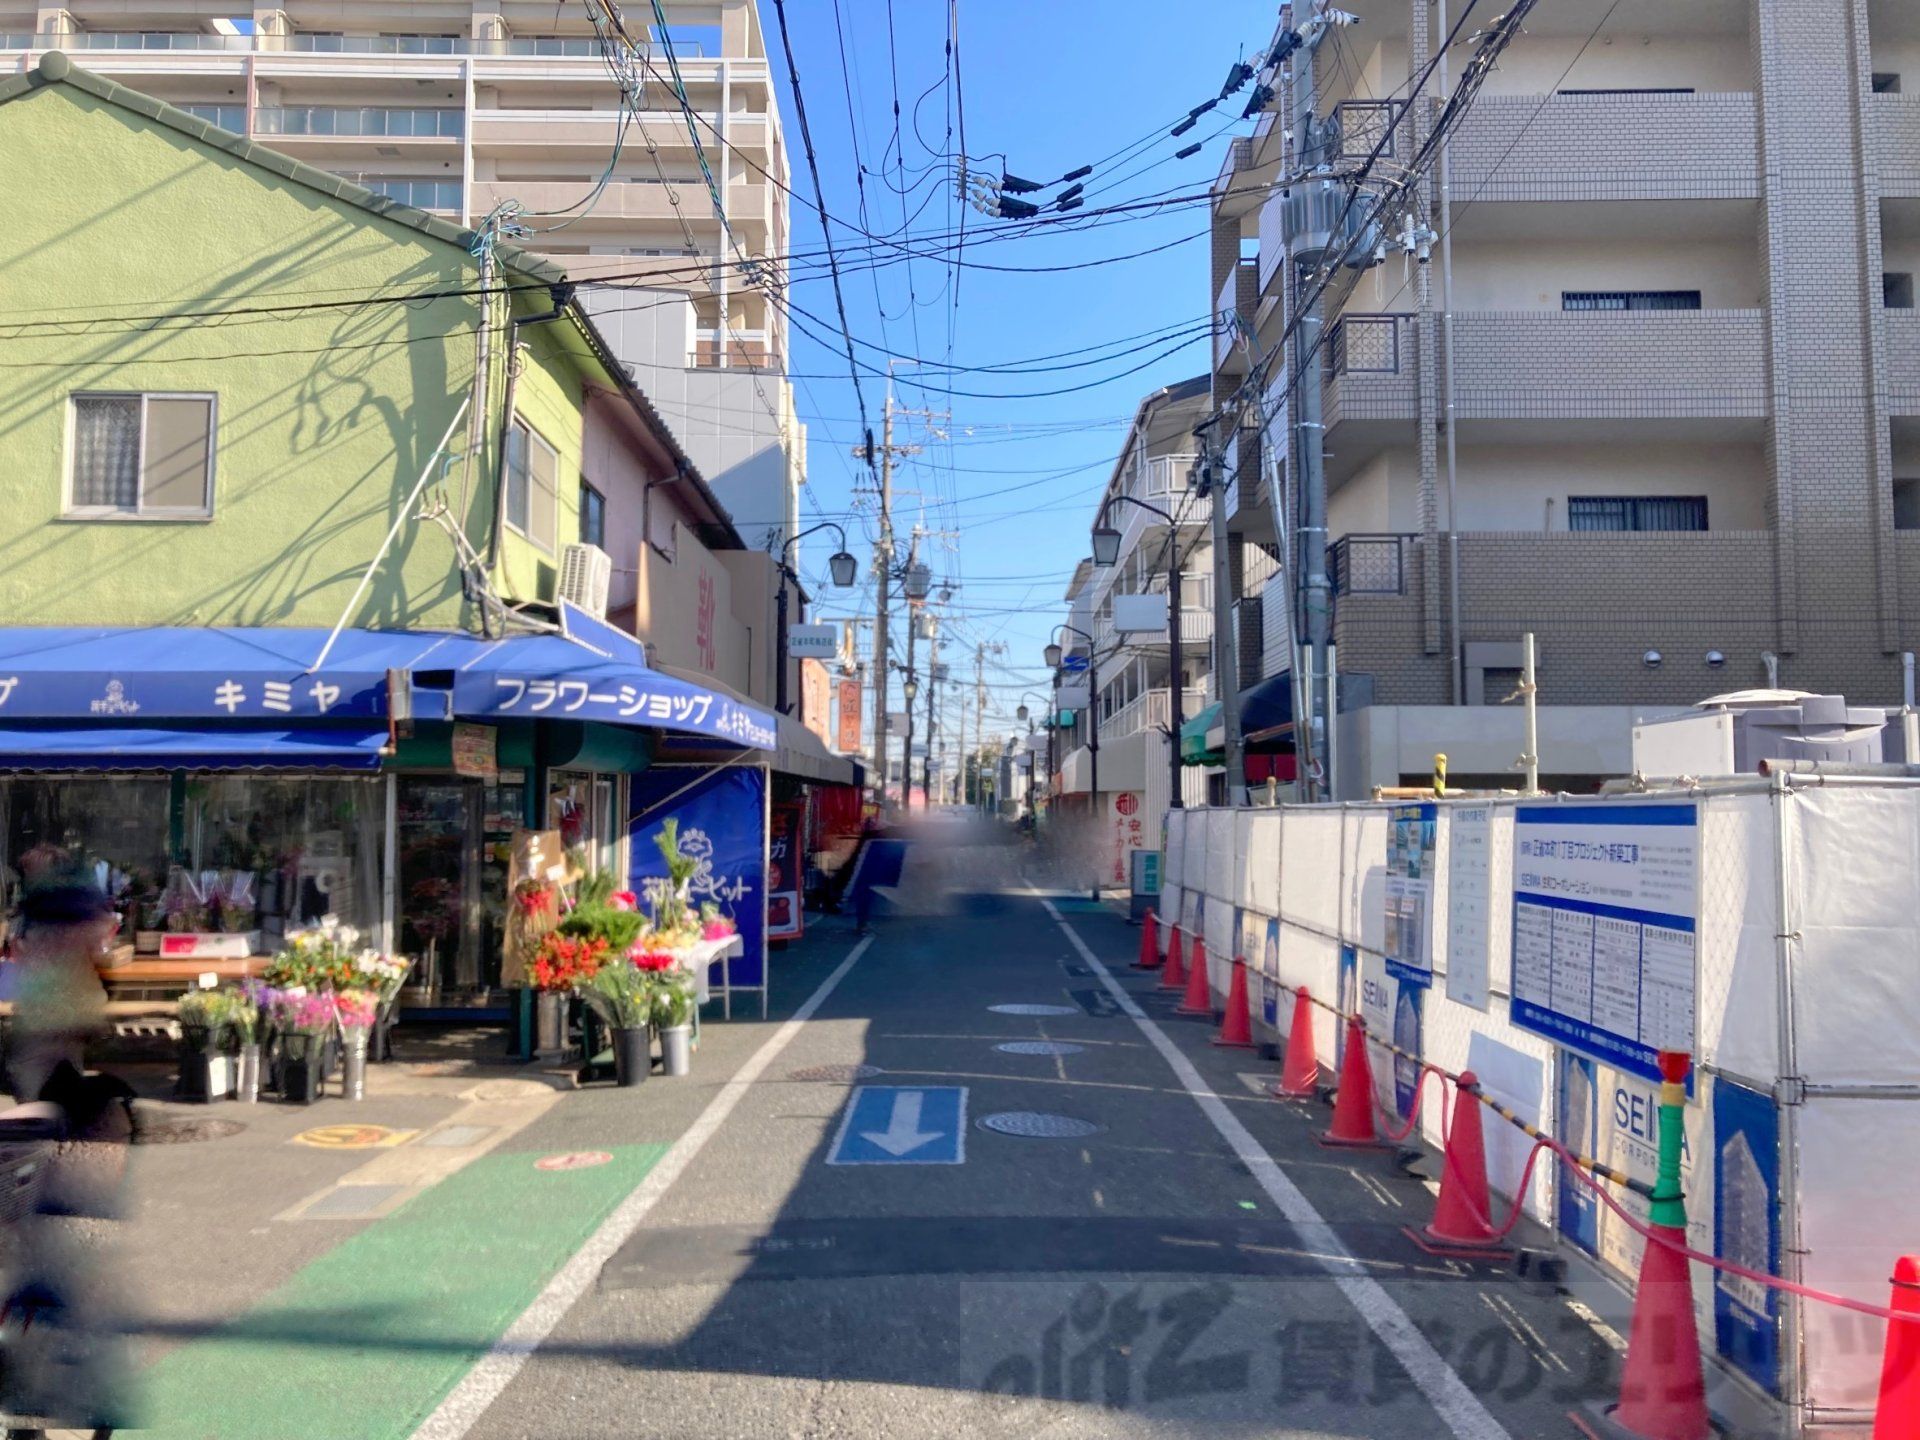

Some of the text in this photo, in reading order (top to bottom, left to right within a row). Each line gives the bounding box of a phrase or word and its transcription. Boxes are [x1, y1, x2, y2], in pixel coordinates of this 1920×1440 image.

[214, 679, 341, 714] キミヤ
[496, 678, 714, 726] フラワーショップ
[1615, 1088, 1691, 1162] SEIA
